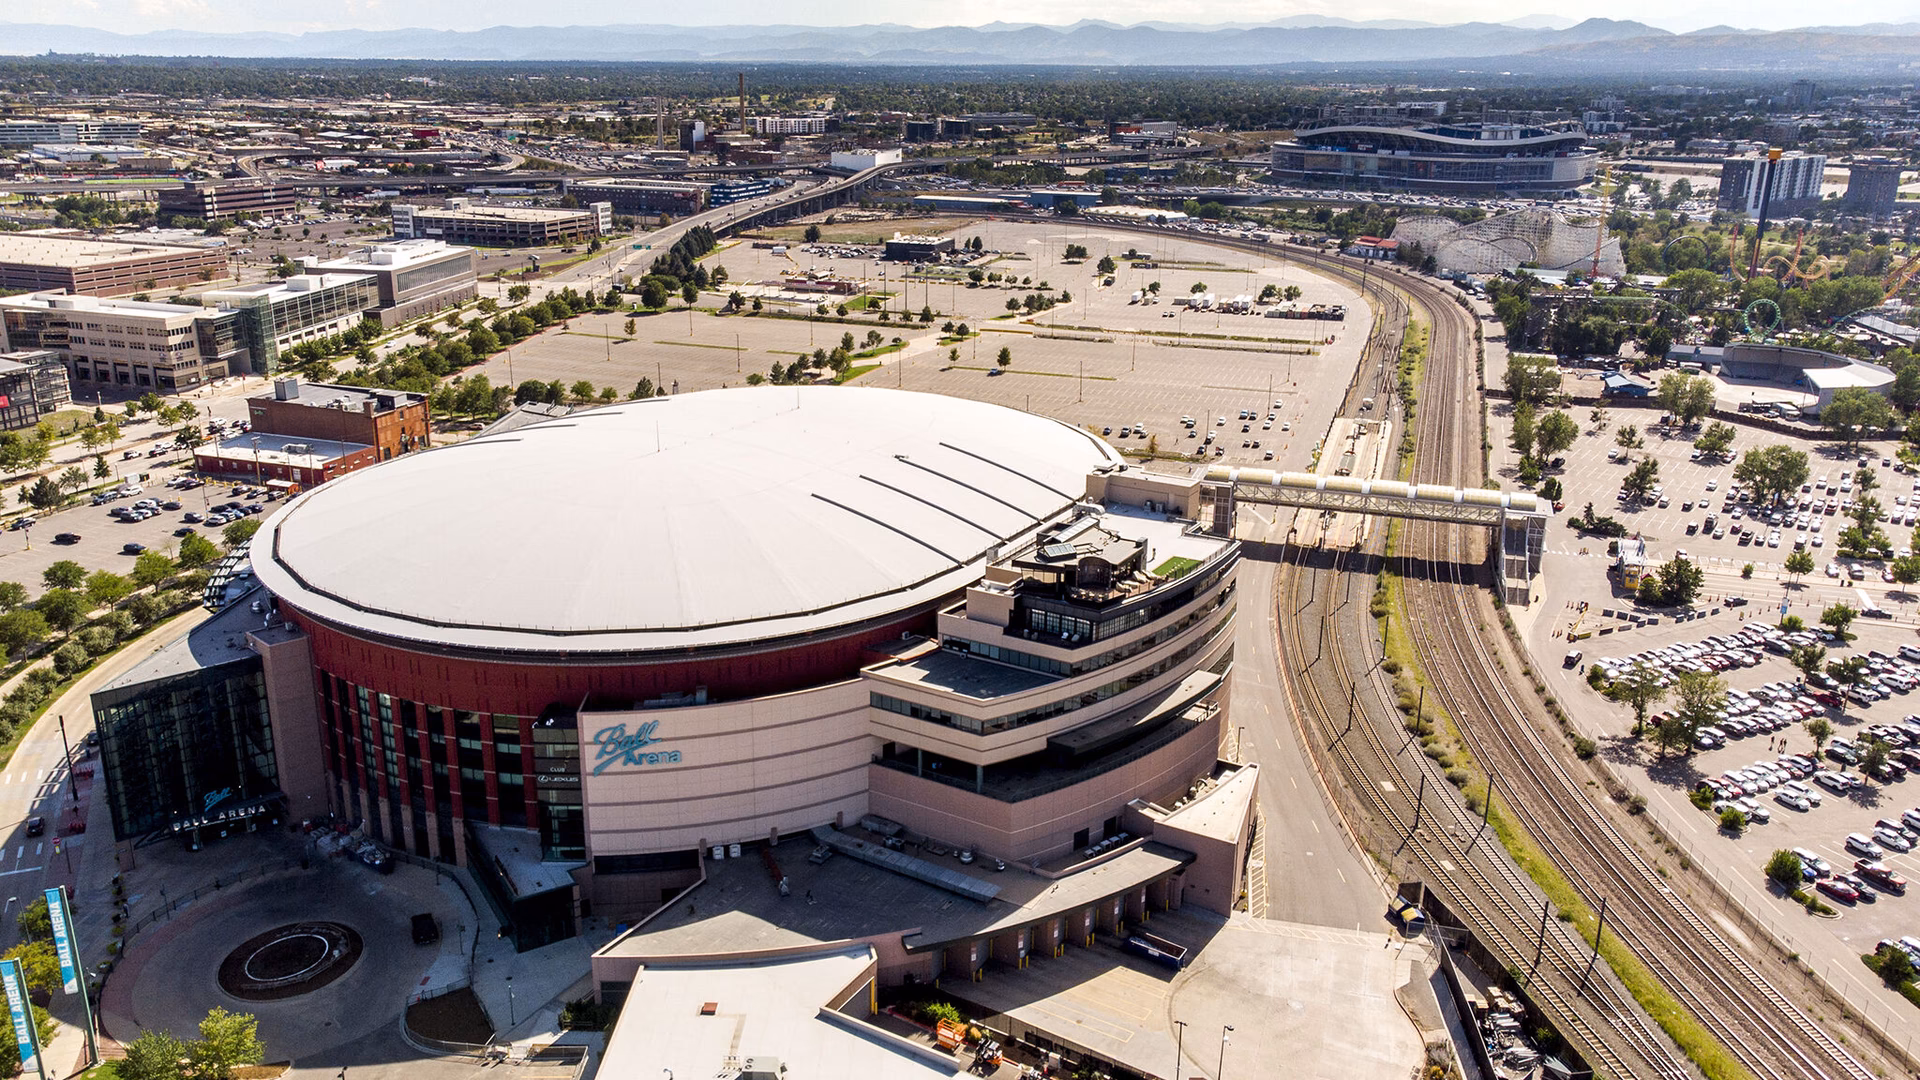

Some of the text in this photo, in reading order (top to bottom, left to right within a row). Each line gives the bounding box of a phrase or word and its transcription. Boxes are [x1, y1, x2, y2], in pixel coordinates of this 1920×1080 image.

[594, 720, 662, 777] Ball
[622, 750, 682, 766] Arena
[173, 816, 208, 831] BALL
[218, 805, 266, 820] ARENA
[50, 901, 73, 967] BALL ARENA
[4, 974, 30, 1044] BALL ARENA
